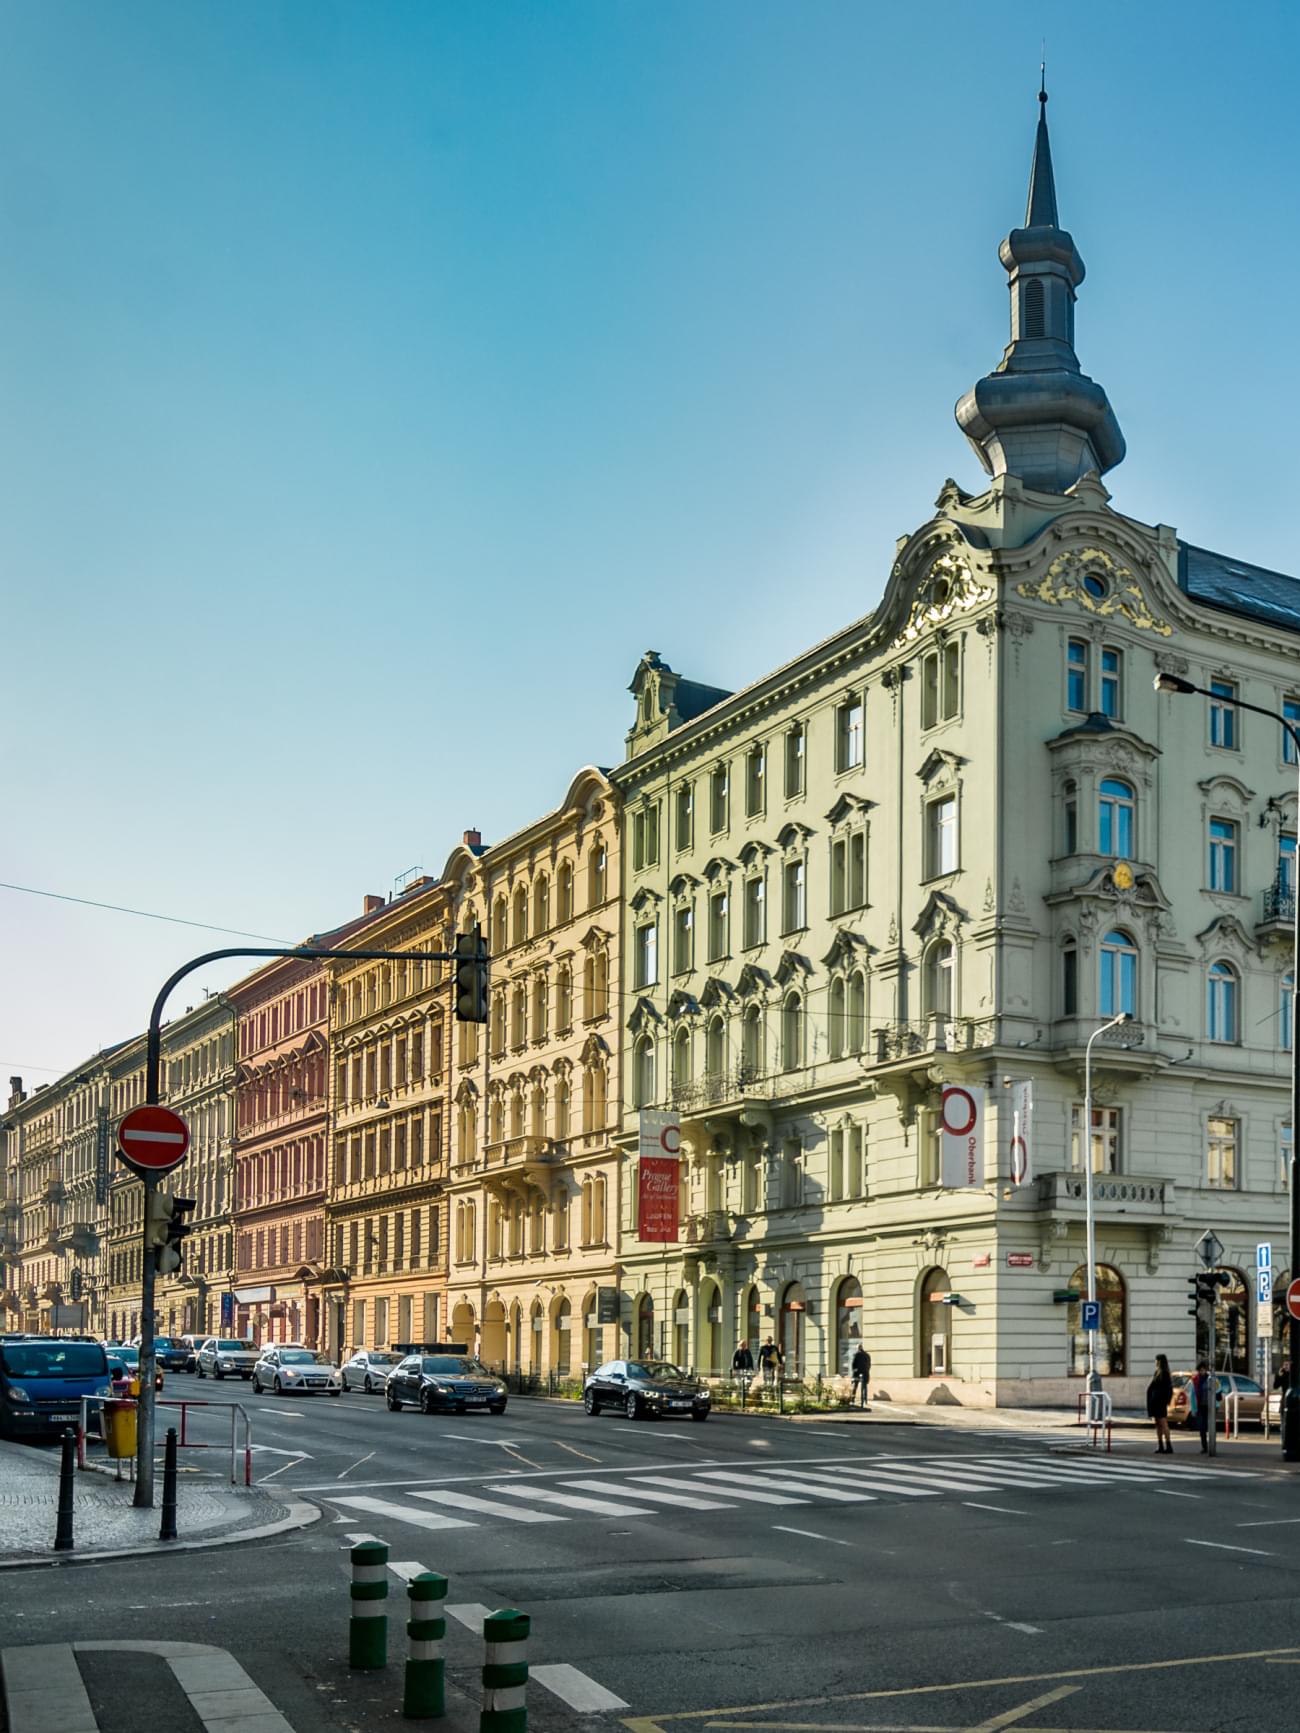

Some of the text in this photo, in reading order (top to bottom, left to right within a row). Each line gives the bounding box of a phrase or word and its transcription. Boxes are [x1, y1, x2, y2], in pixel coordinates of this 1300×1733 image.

[968, 1137, 976, 1184] Oberbank
[642, 1169, 672, 1184] Prague
[646, 1180, 678, 1196] Gallery
[1085, 1305, 1096, 1321] P
